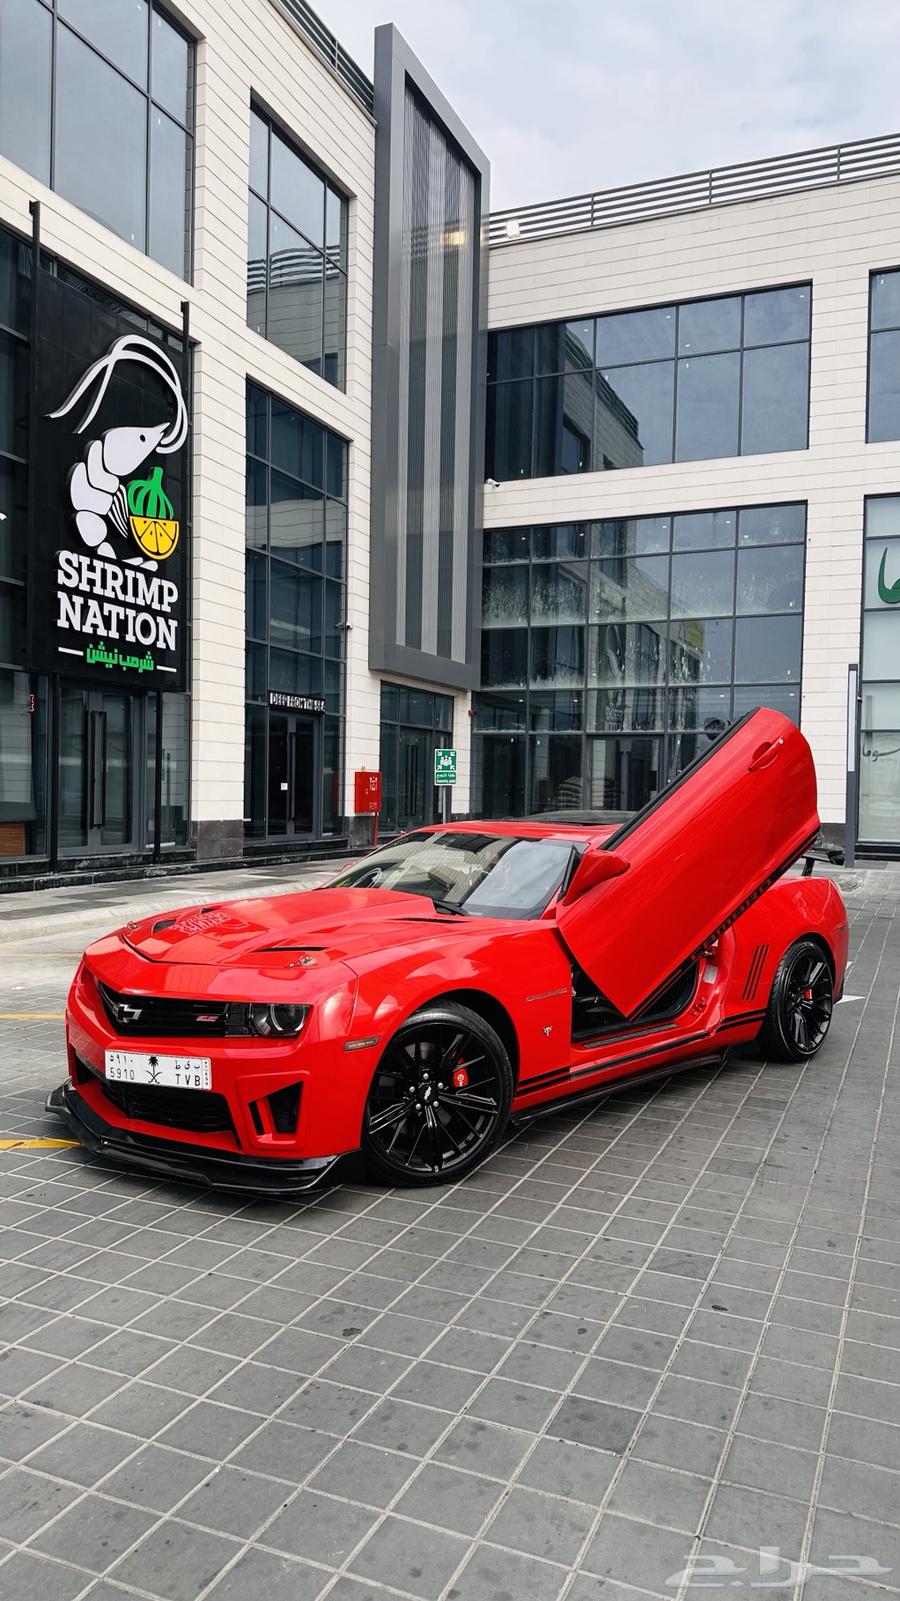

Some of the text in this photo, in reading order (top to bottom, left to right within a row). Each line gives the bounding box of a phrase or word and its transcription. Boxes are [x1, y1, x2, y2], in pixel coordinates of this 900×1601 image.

[57, 550, 179, 613] SHRIMP
[57, 591, 178, 651] NATION
[87, 641, 154, 673] شرمب نيشن
[110, 1067, 135, 1081] 5910
